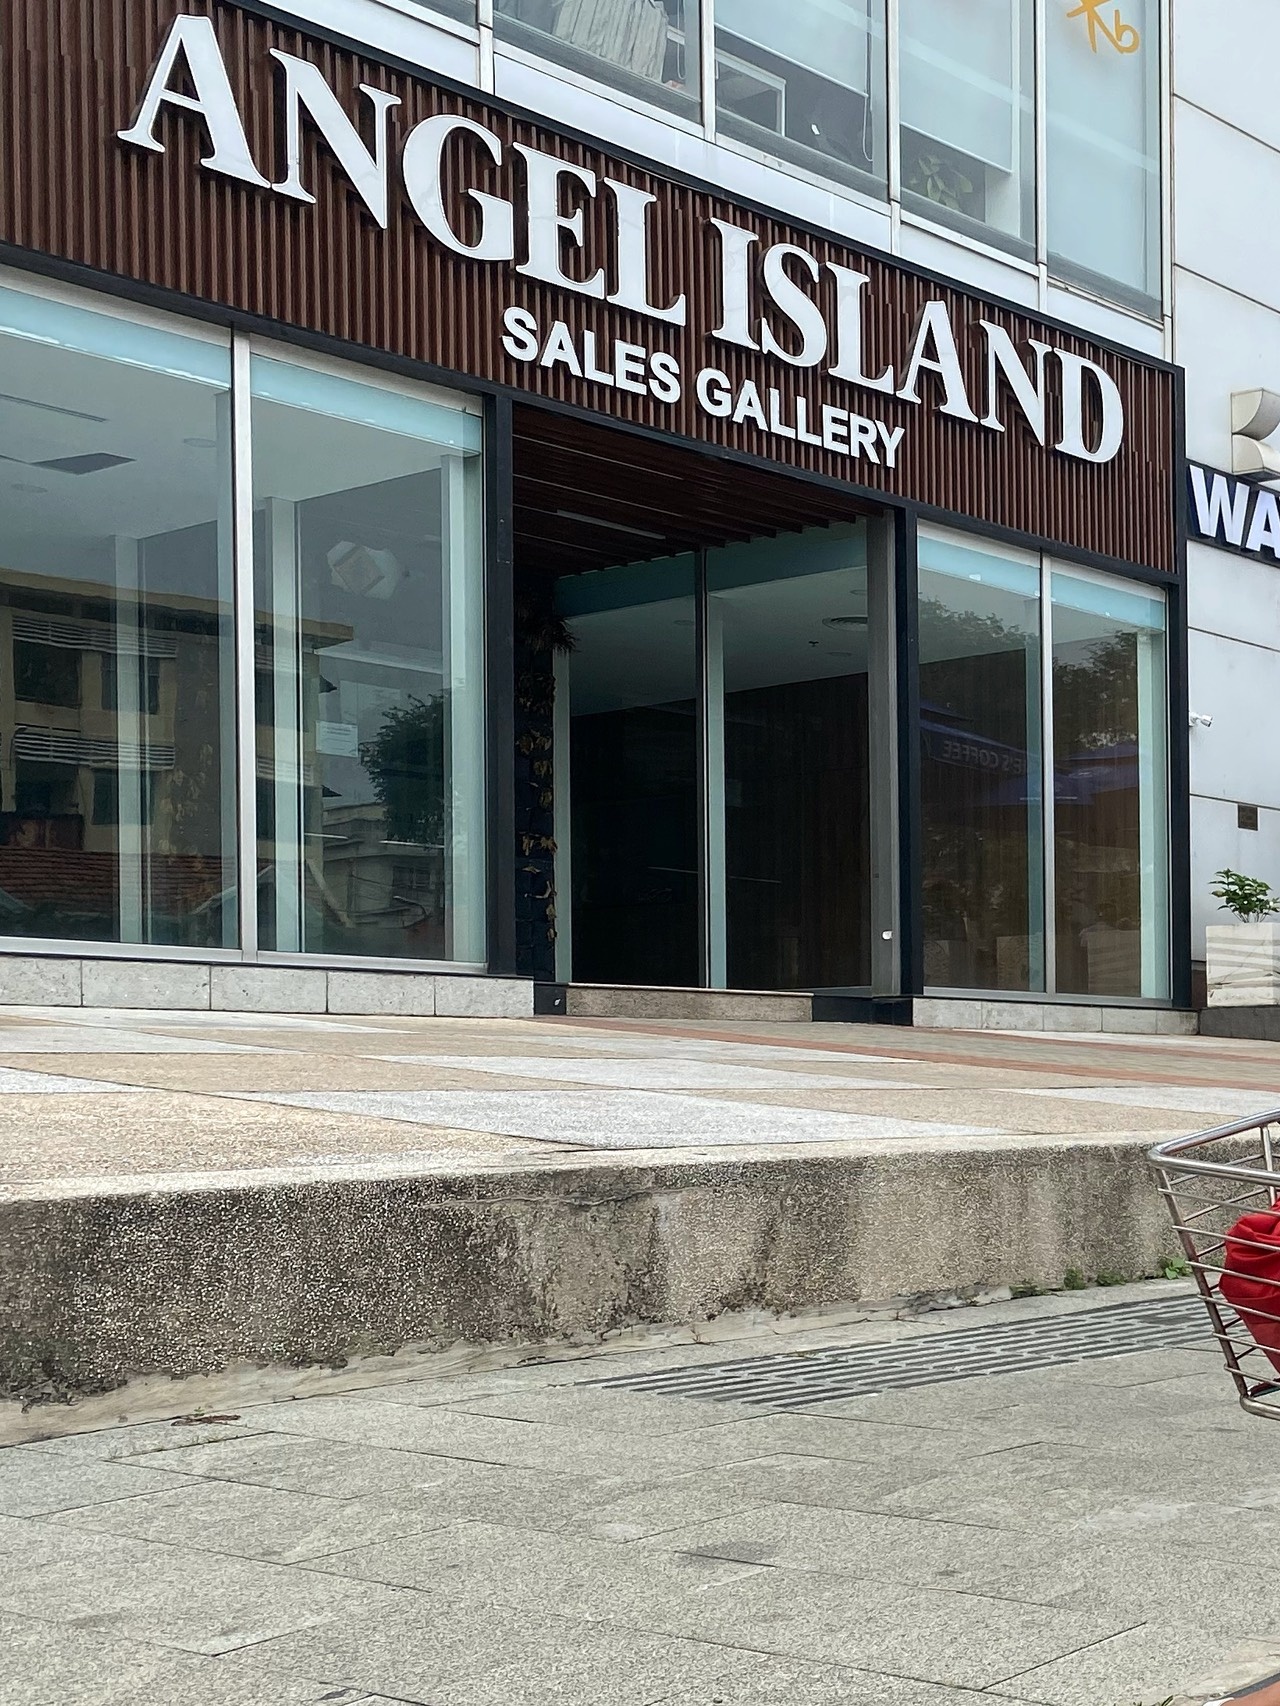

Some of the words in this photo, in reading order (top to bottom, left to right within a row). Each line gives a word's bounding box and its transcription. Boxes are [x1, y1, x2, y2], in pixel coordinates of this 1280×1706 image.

[117, 14, 686, 326] ANGEL
[710, 217, 1124, 463] ISLAND
[502, 306, 681, 403] SALES
[696, 368, 905, 468] GALLERY
